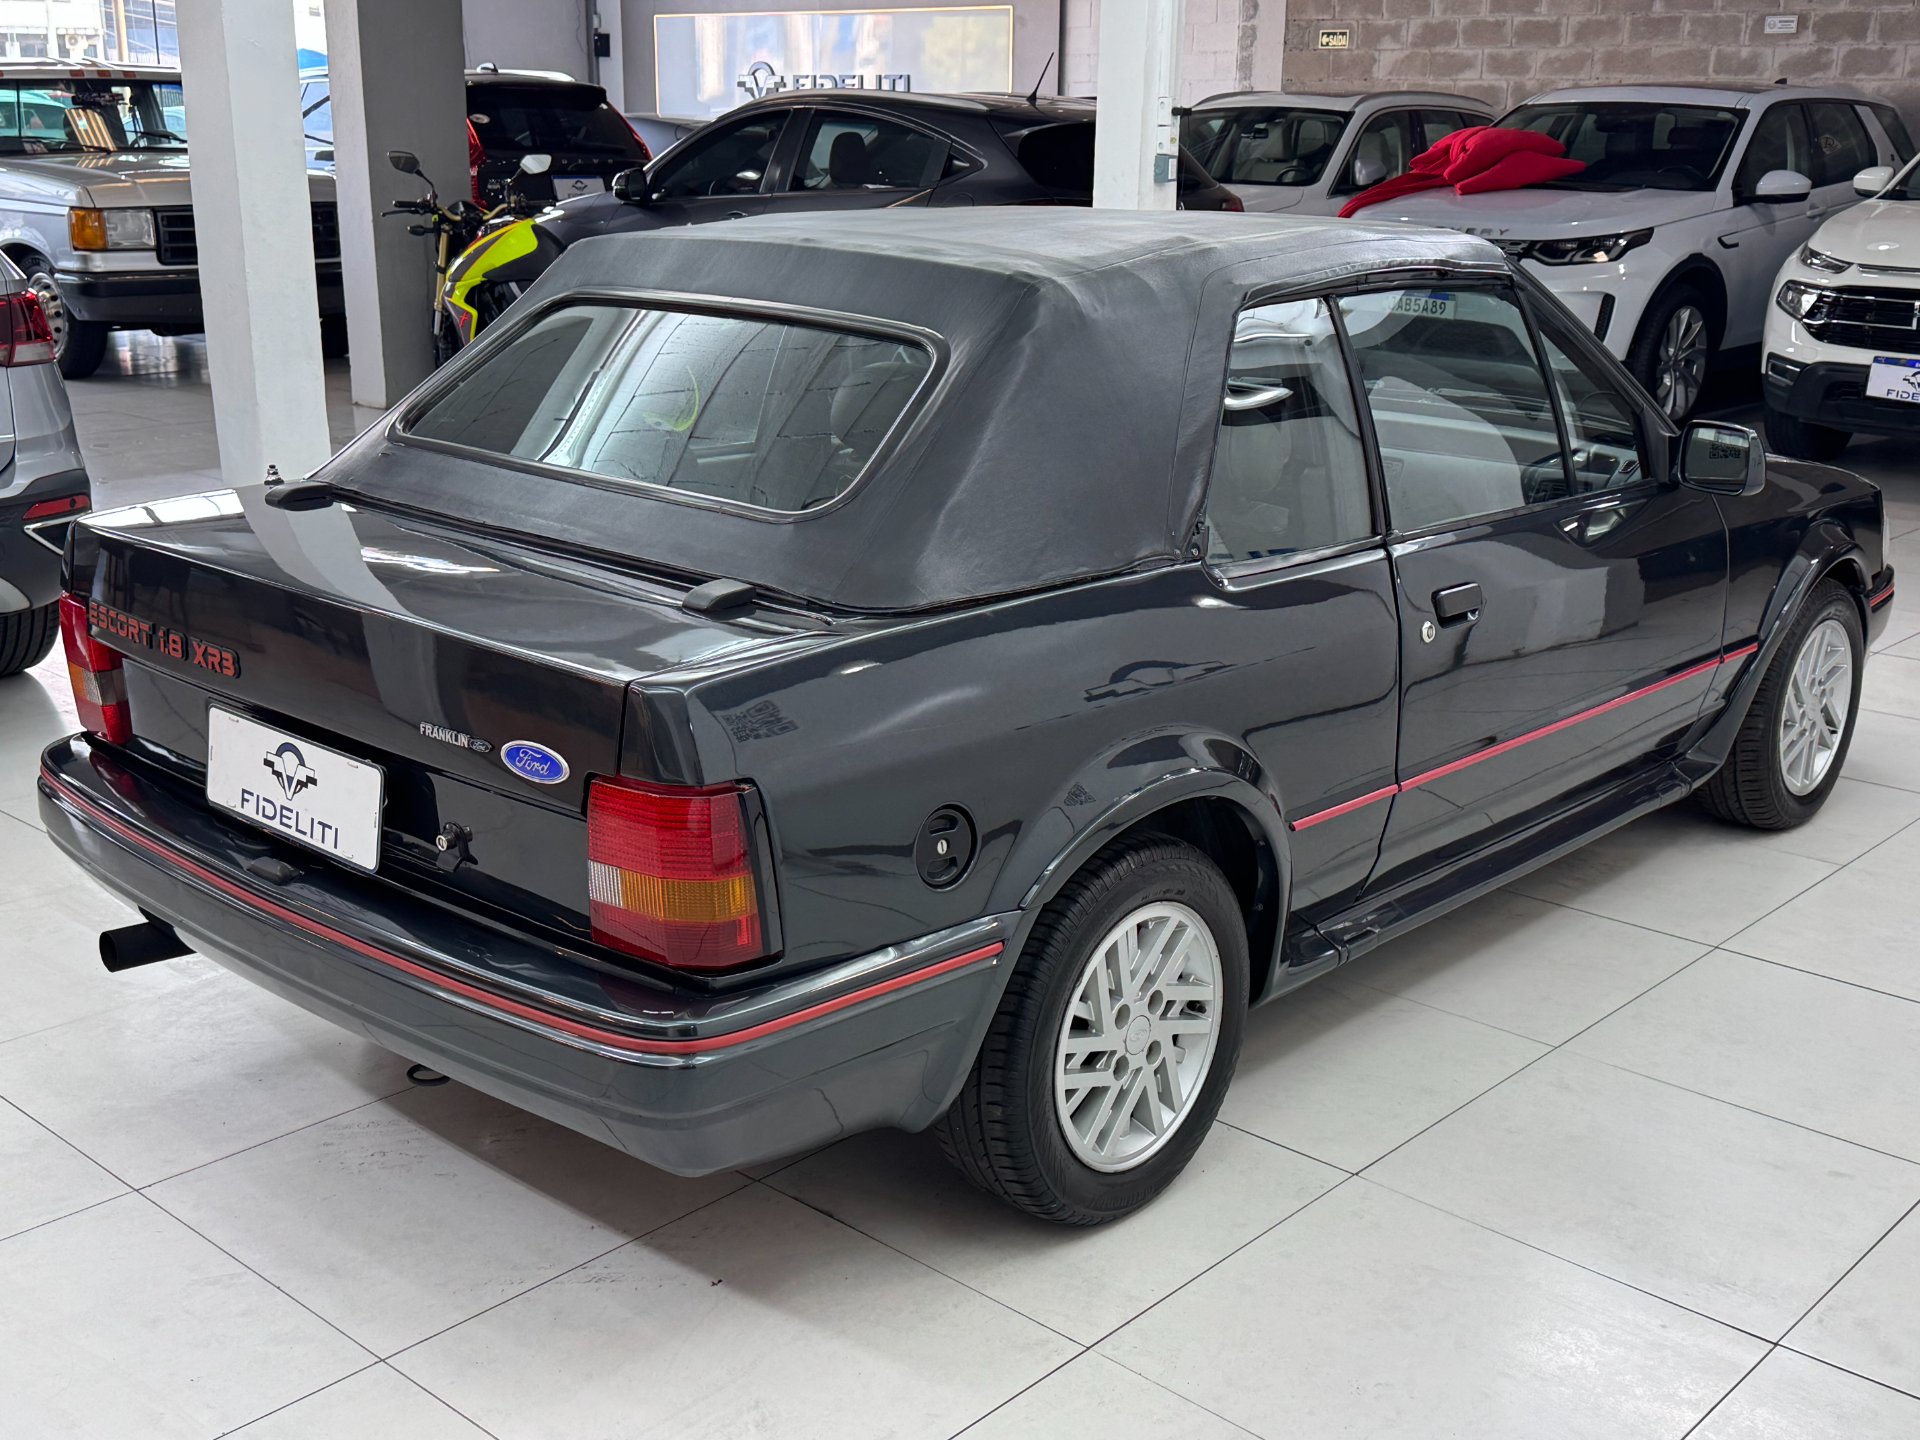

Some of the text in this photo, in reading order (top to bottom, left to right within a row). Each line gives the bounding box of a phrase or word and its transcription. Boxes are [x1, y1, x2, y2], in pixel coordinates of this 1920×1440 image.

[1329, 32, 1347, 46] SAÍDA
[89, 601, 236, 678] ESCORT 1.8 XR3
[419, 721, 469, 749] FRANKLIN
[515, 748, 551, 776] Ford
[240, 787, 339, 850] FIDELITI
